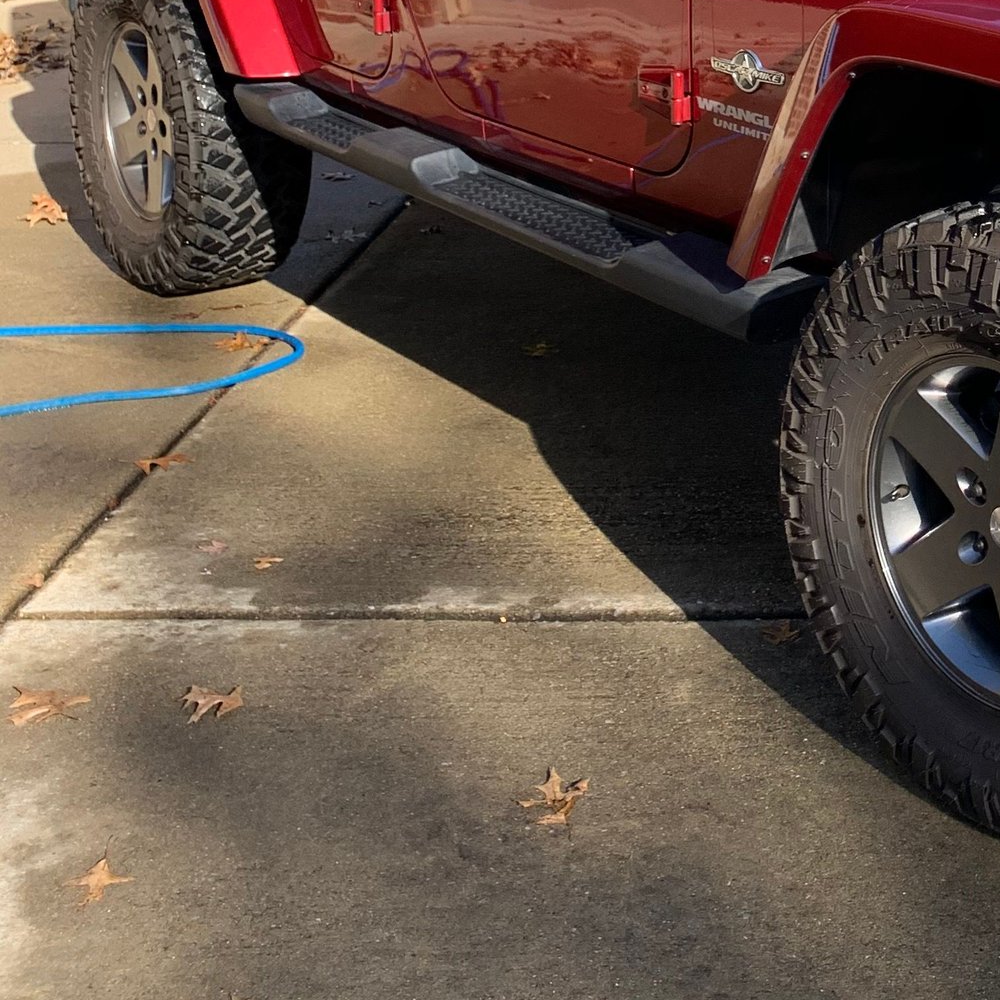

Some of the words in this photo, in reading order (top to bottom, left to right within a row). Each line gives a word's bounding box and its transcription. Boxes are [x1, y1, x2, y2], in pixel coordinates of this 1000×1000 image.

[752, 70, 781, 83] MIKE
[696, 96, 774, 128] WRANGL
[713, 118, 770, 141] UNLIMIT
